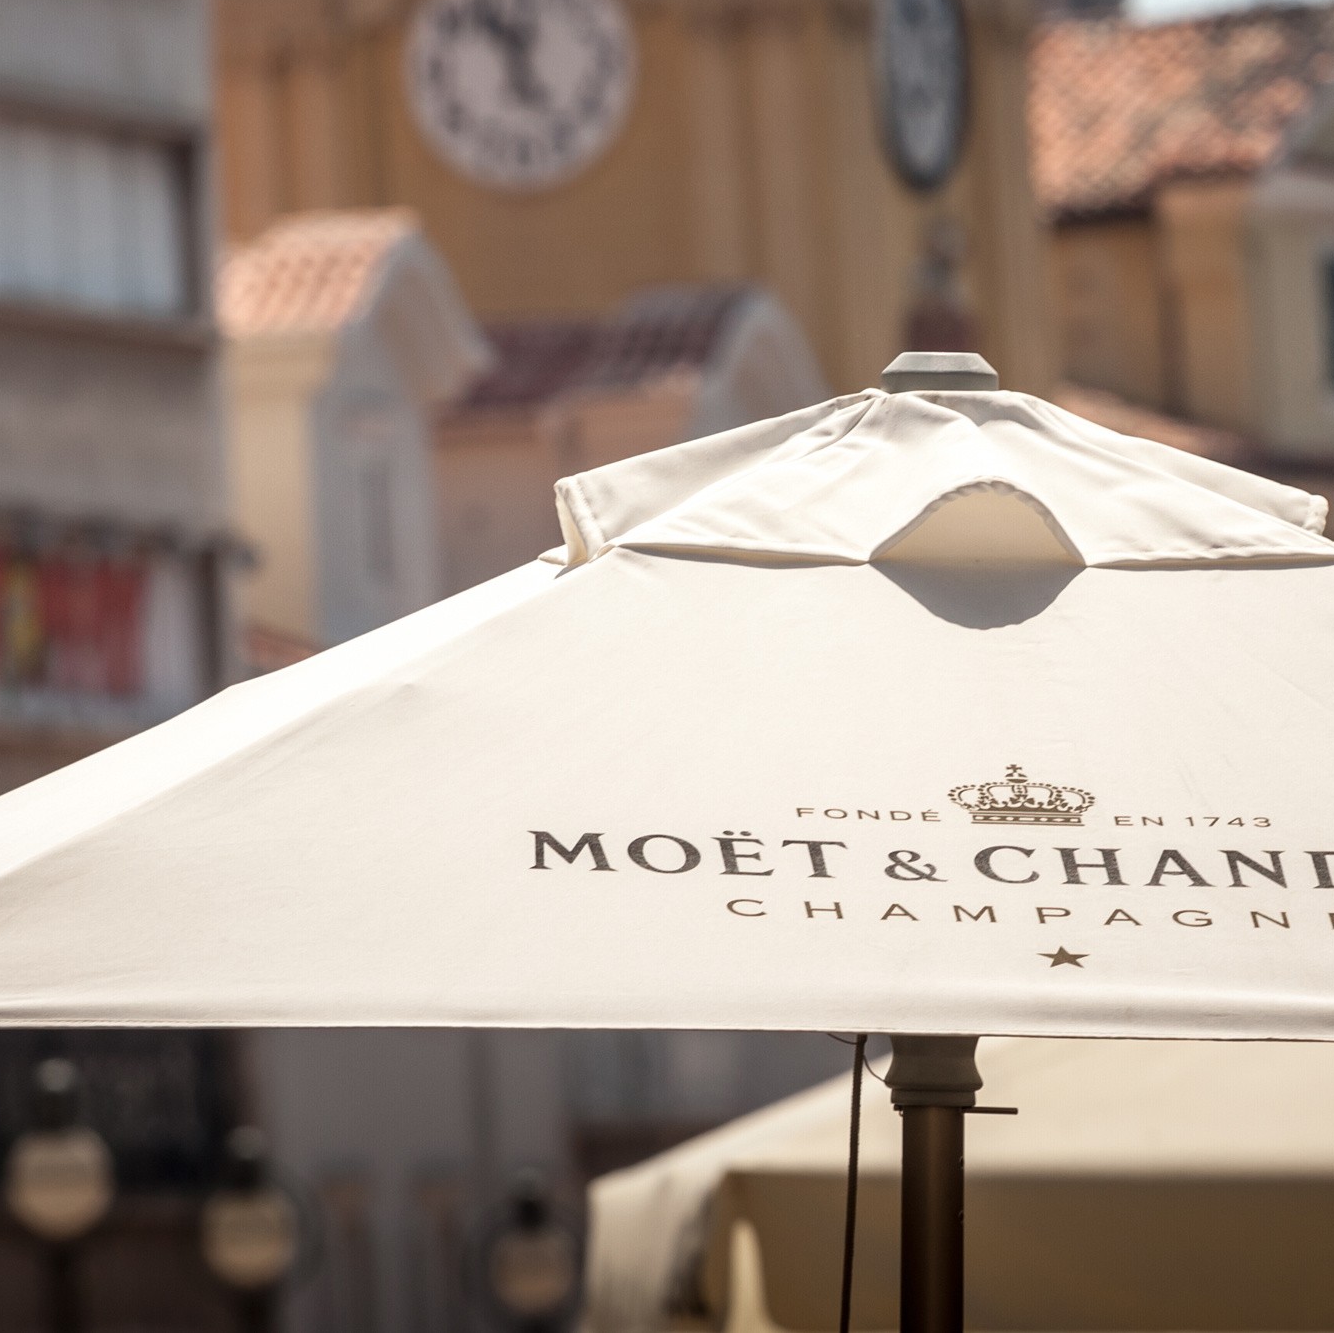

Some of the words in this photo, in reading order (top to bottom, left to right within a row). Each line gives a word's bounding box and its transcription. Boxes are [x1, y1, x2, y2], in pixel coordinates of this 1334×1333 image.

[794, 806, 942, 823] FONDÉ
[1113, 815, 1164, 827] EN
[1185, 815, 1273, 828] 1743
[527, 829, 849, 879] MOËT
[883, 849, 948, 883] &
